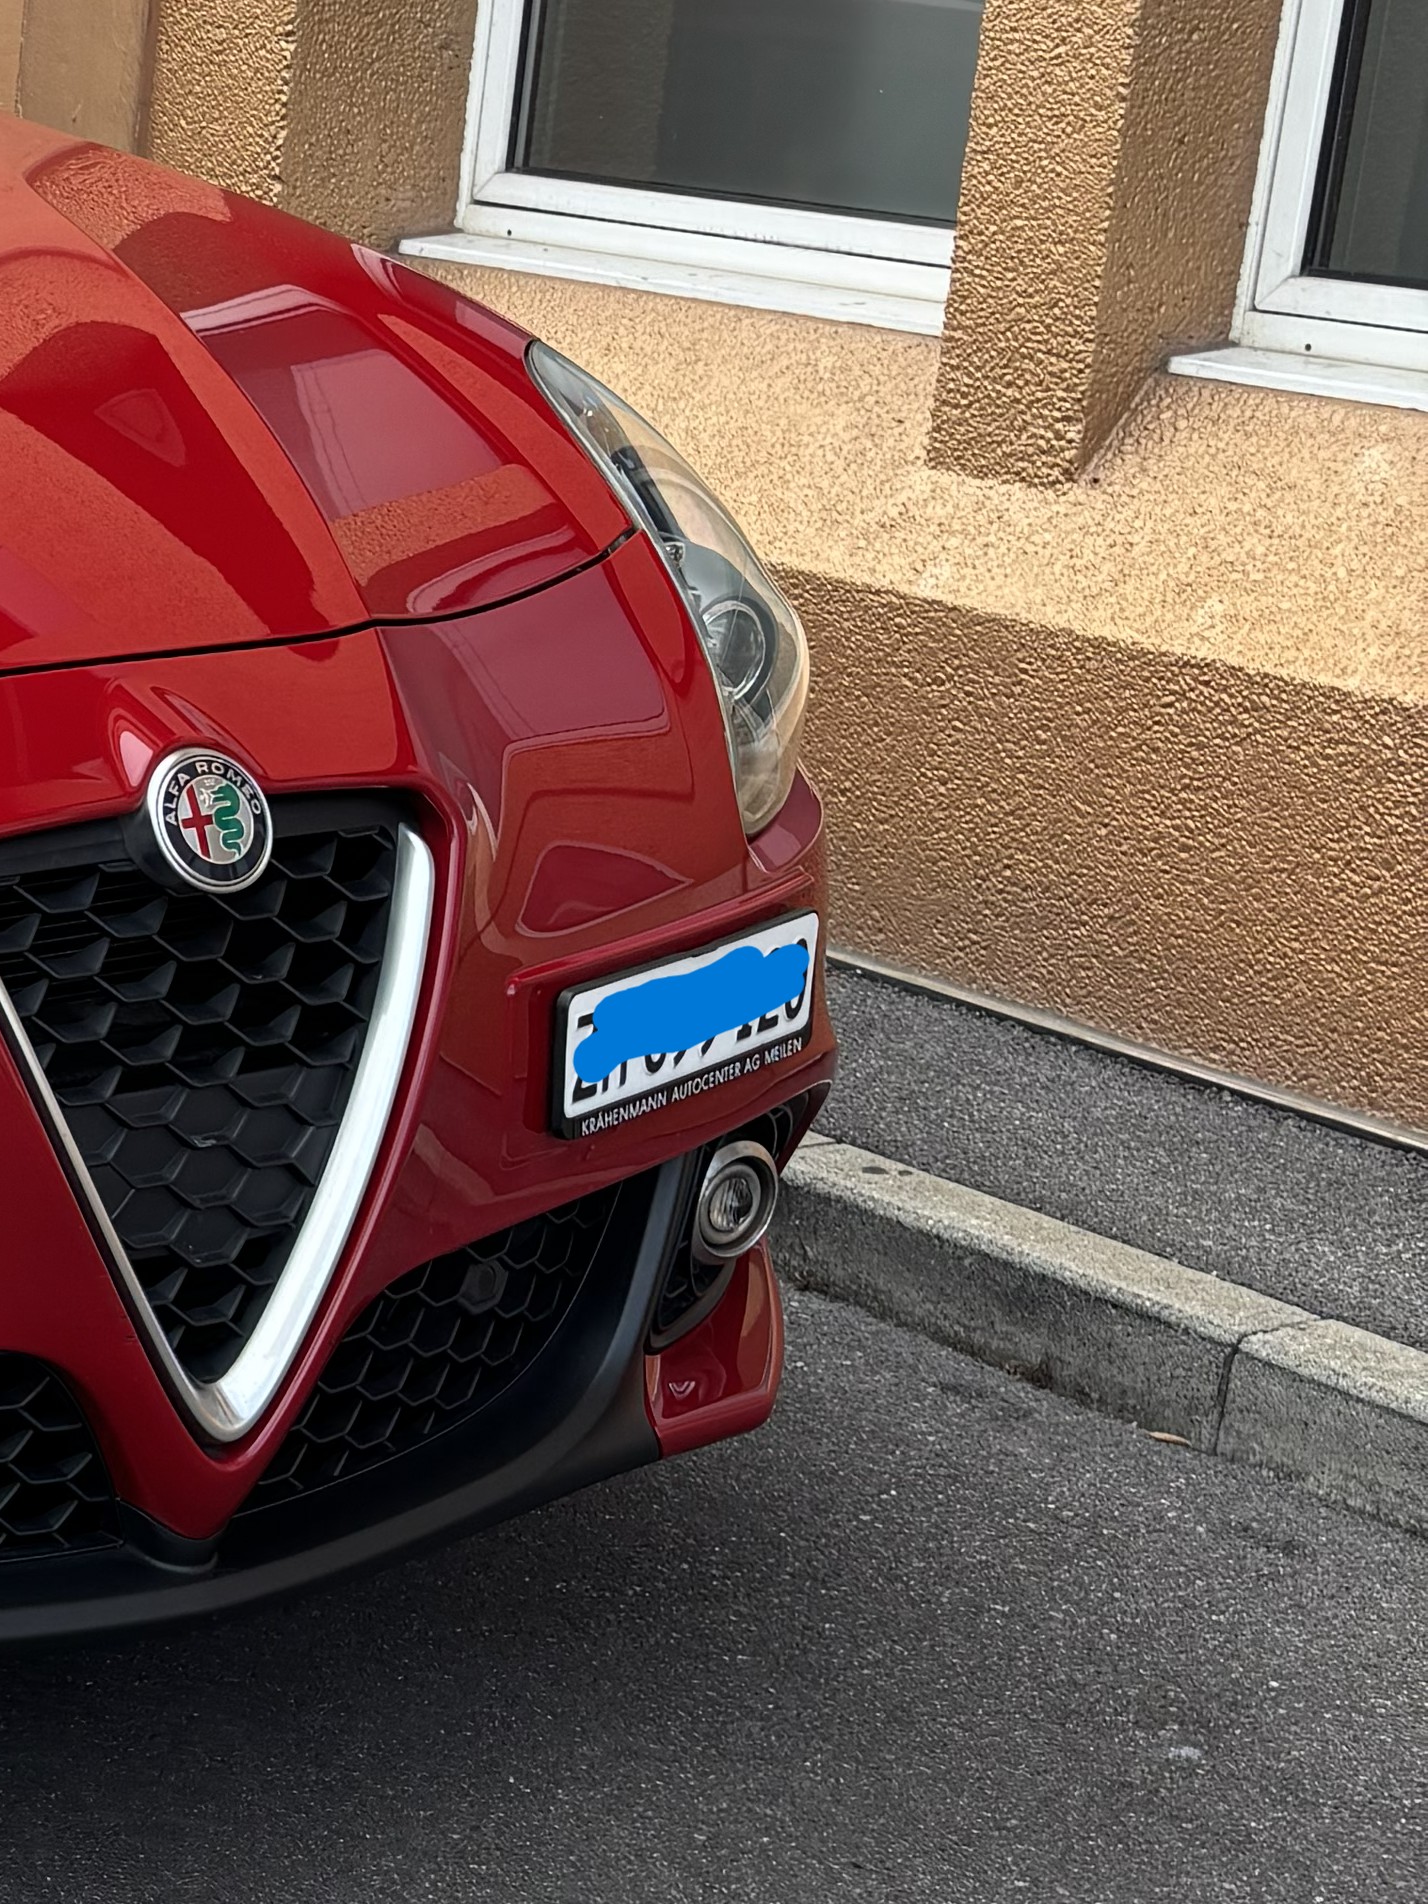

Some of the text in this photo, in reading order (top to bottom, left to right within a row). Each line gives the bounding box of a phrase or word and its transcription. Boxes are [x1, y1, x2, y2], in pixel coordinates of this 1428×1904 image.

[164, 761, 262, 826] ALFA ROMEO
[671, 1061, 741, 1103] AUTOCENTER
[743, 1053, 761, 1074] AG
[764, 1036, 802, 1066] MEILEN
